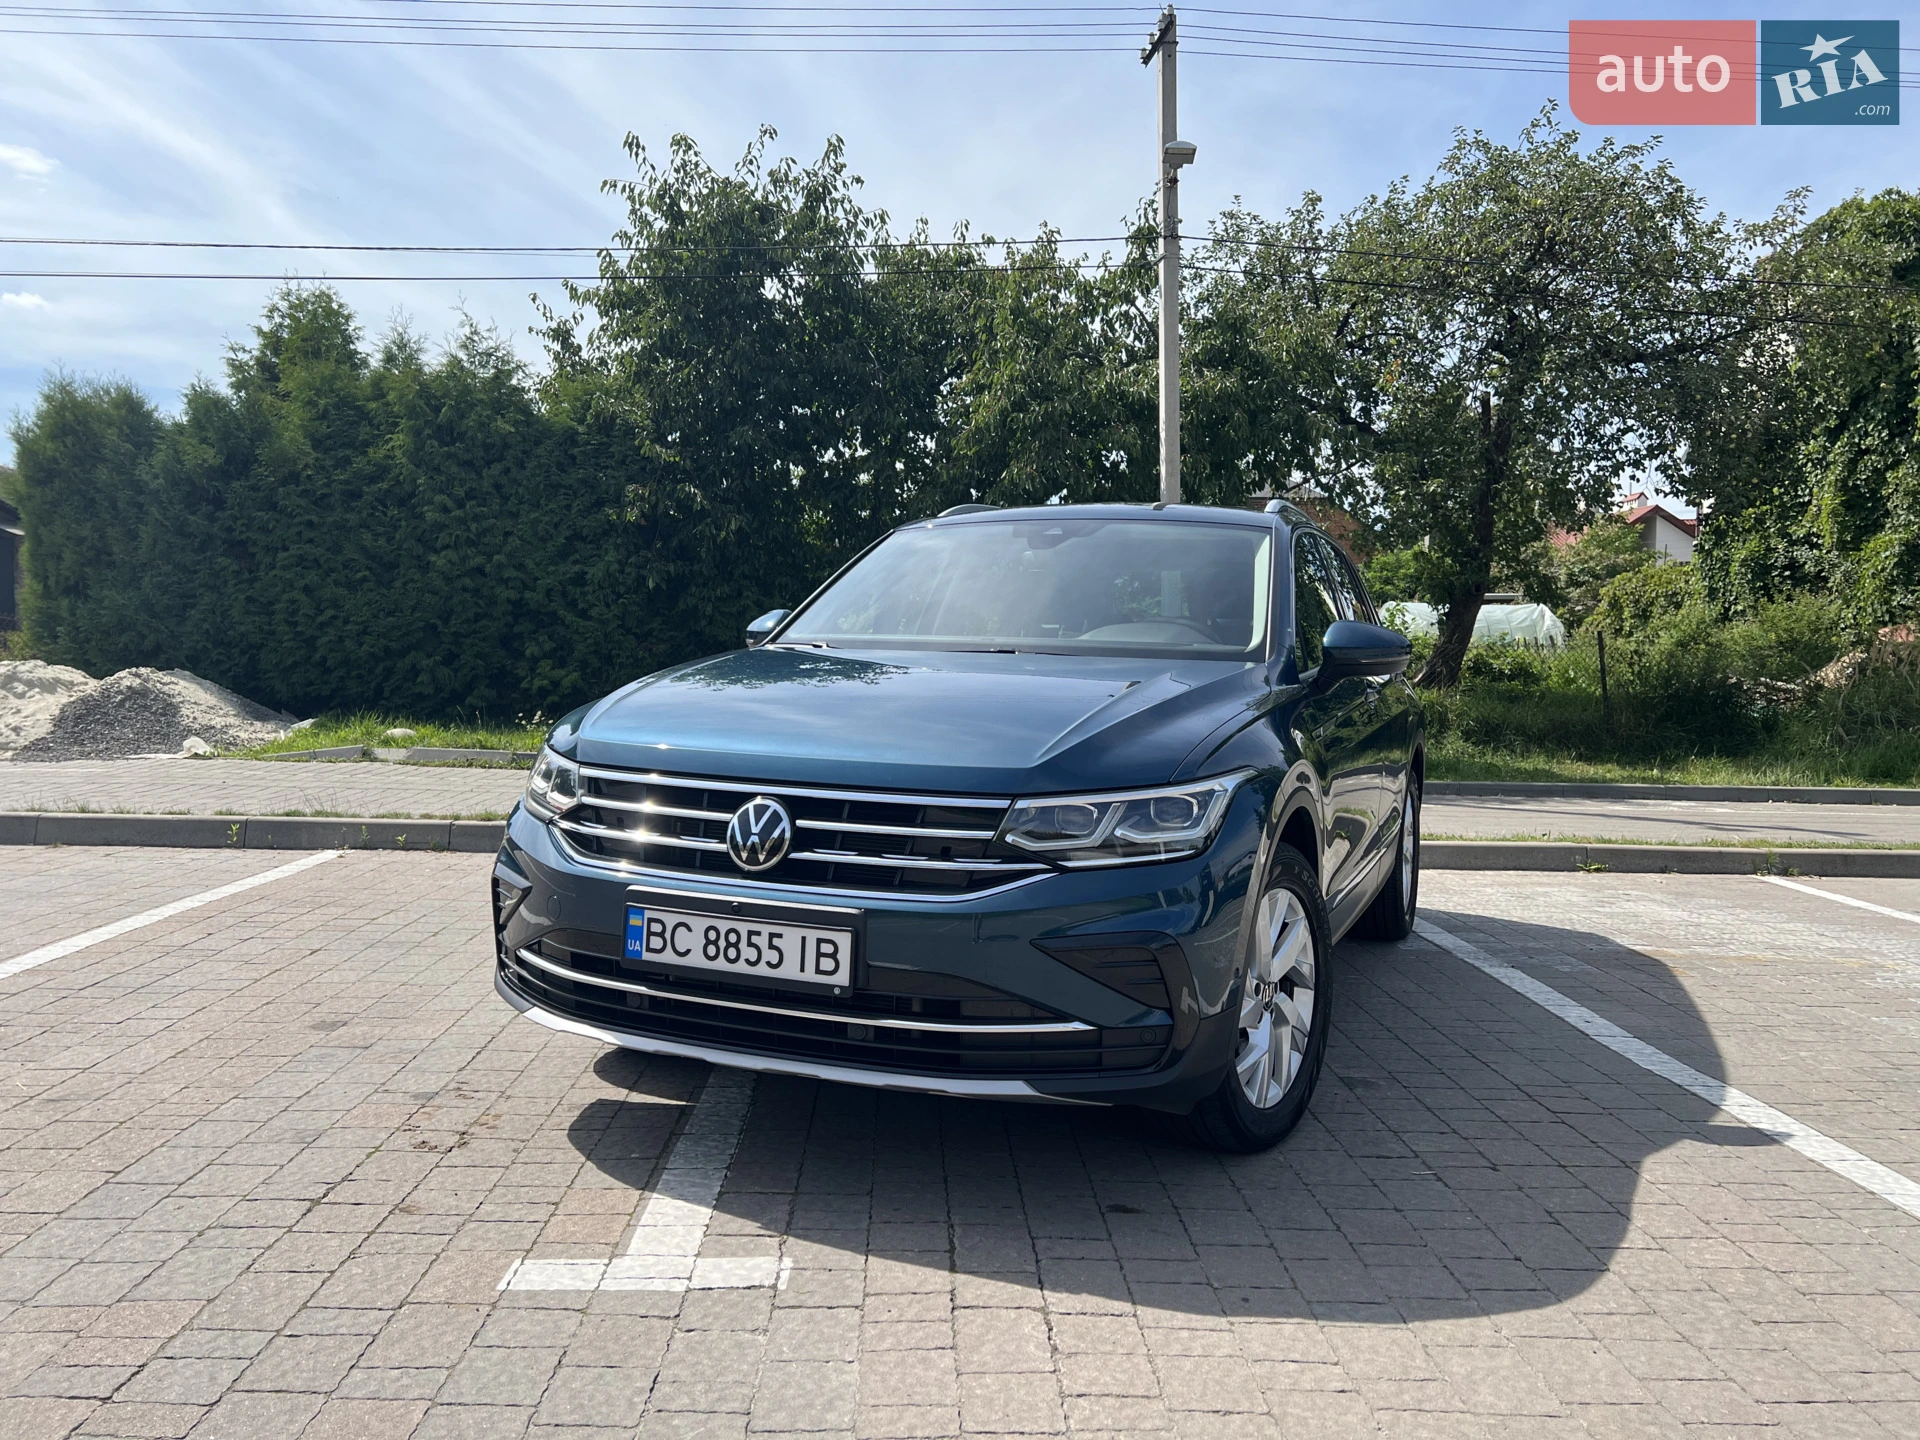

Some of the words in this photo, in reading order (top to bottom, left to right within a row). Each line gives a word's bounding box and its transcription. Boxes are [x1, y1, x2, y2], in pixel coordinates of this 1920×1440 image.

[627, 938, 641, 951] UA
[645, 917, 693, 958] BC
[702, 925, 785, 970] 8855
[799, 935, 841, 977] IB
